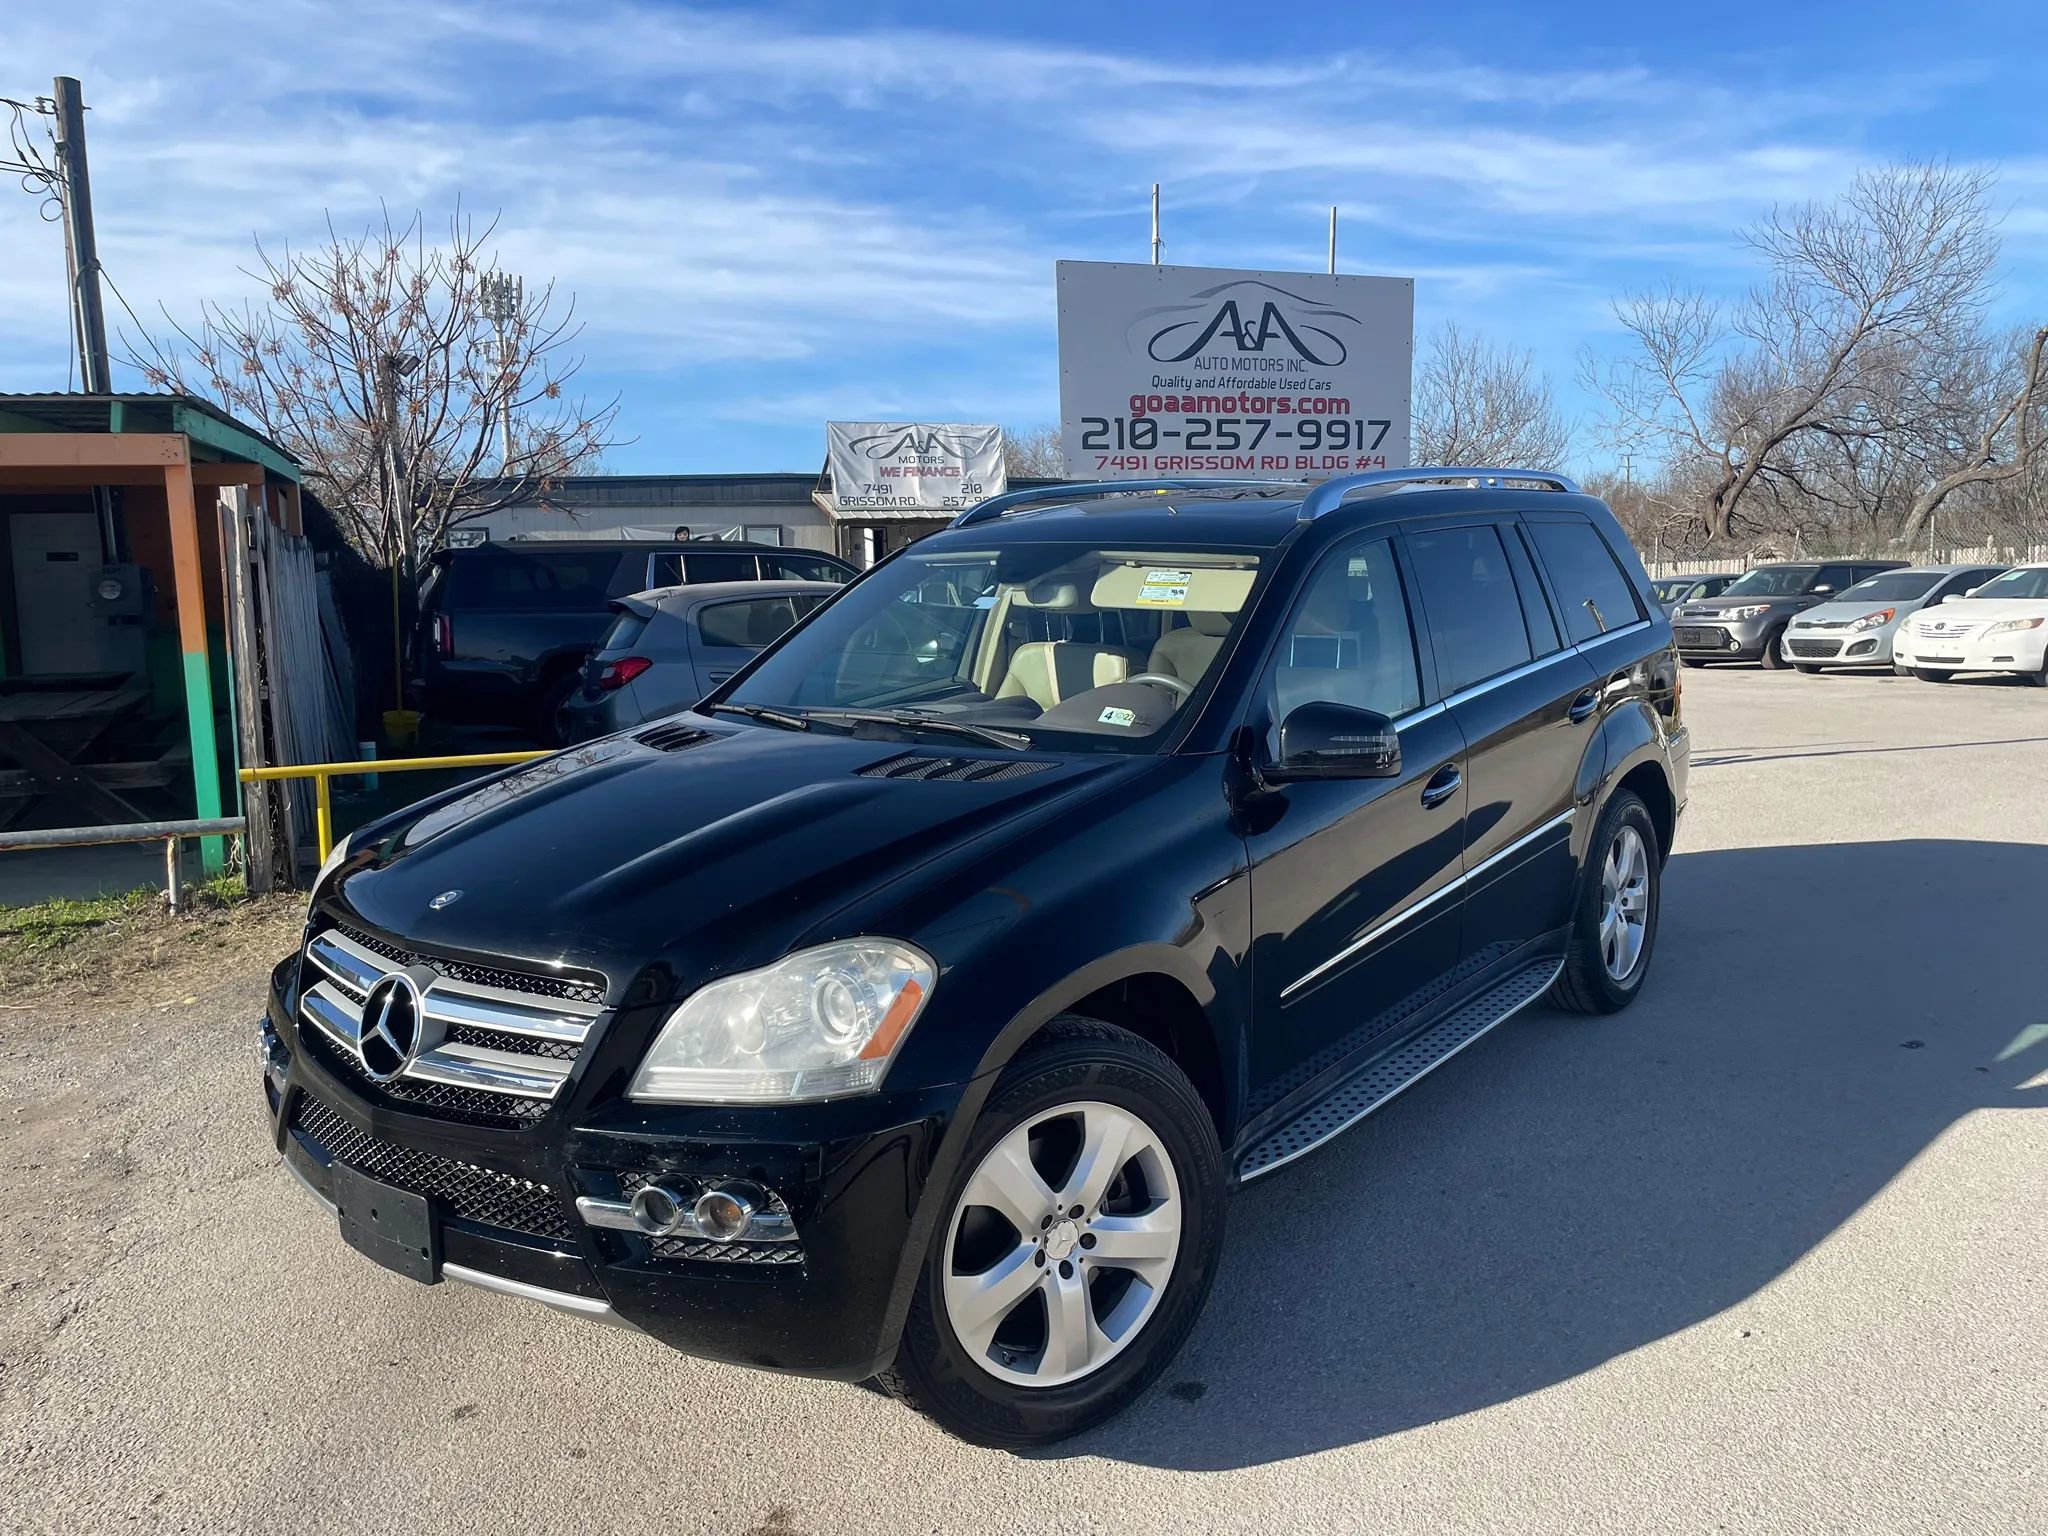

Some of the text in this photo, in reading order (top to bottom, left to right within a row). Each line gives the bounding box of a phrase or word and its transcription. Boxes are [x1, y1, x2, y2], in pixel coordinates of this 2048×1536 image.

[1194, 356, 1308, 372] AUTO MOTORS INC.
[1152, 375, 1332, 391] Quality and Affordable Used Cars
[1129, 391, 1350, 418] goaamotors.com
[1081, 417, 1392, 451] 210-257-9917
[898, 455, 945, 464] MOTORS
[1095, 455, 1386, 471] 7491 GRISSOM RD BLDG #4
[879, 466, 961, 478] WE FINANCE
[864, 483, 893, 494] 7491
[961, 483, 983, 494] 210
[839, 496, 897, 507] GRISSOM
[1104, 710, 1114, 721] 4
